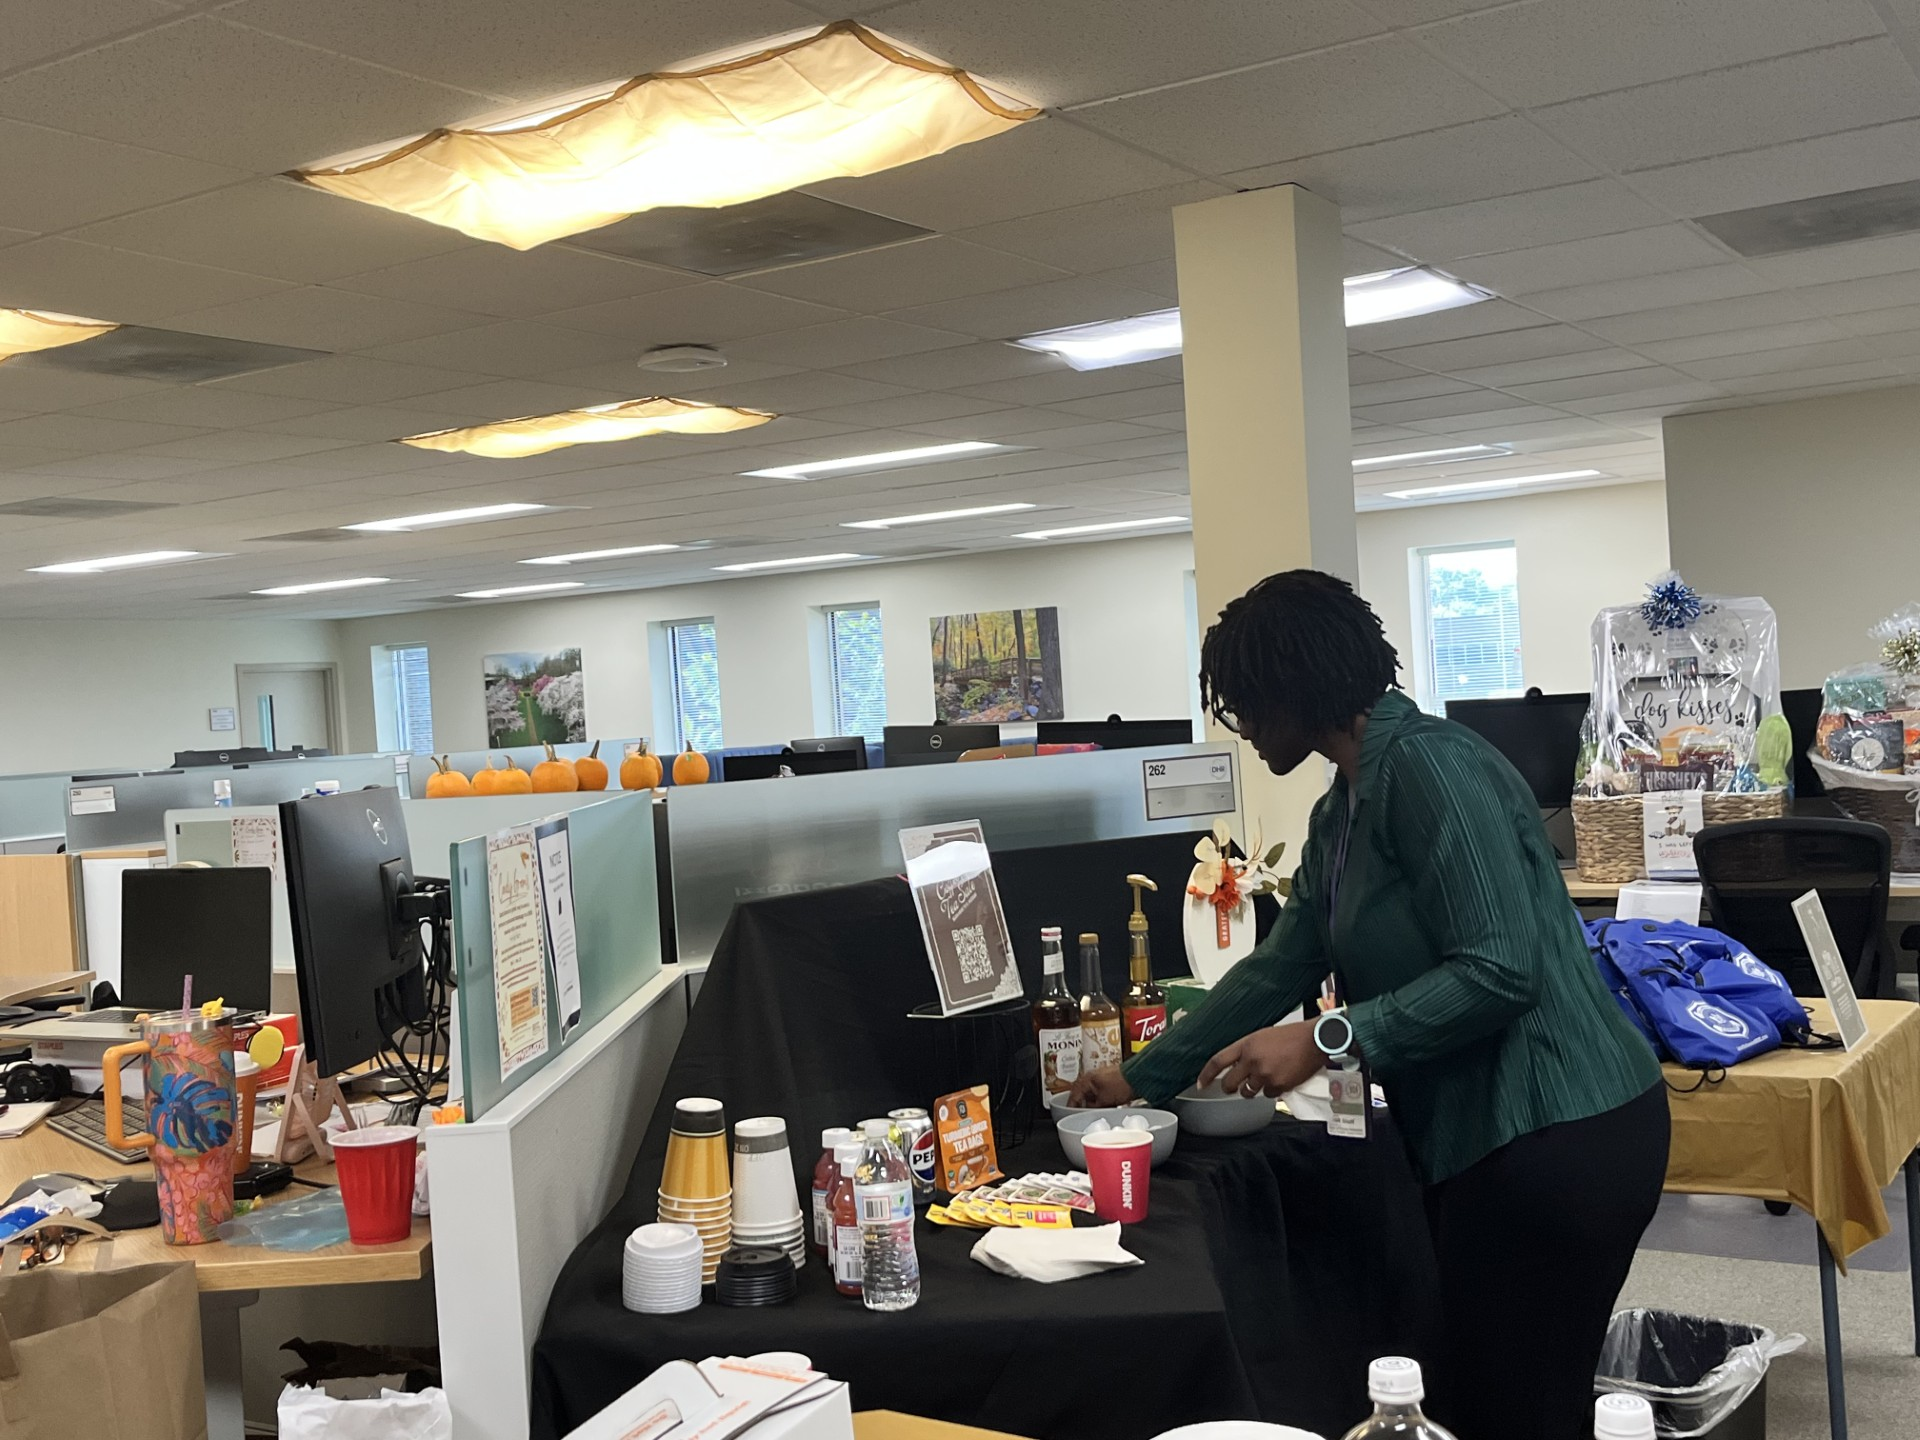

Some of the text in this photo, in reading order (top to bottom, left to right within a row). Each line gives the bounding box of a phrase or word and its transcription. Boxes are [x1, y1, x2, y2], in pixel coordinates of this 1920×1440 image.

[1635, 687, 1736, 728] dog kisses
[1148, 764, 1166, 776] 262
[1135, 1014, 1167, 1042] Tora
[912, 1149, 934, 1165] PEP
[1121, 1160, 1133, 1211] DUNKIN'
